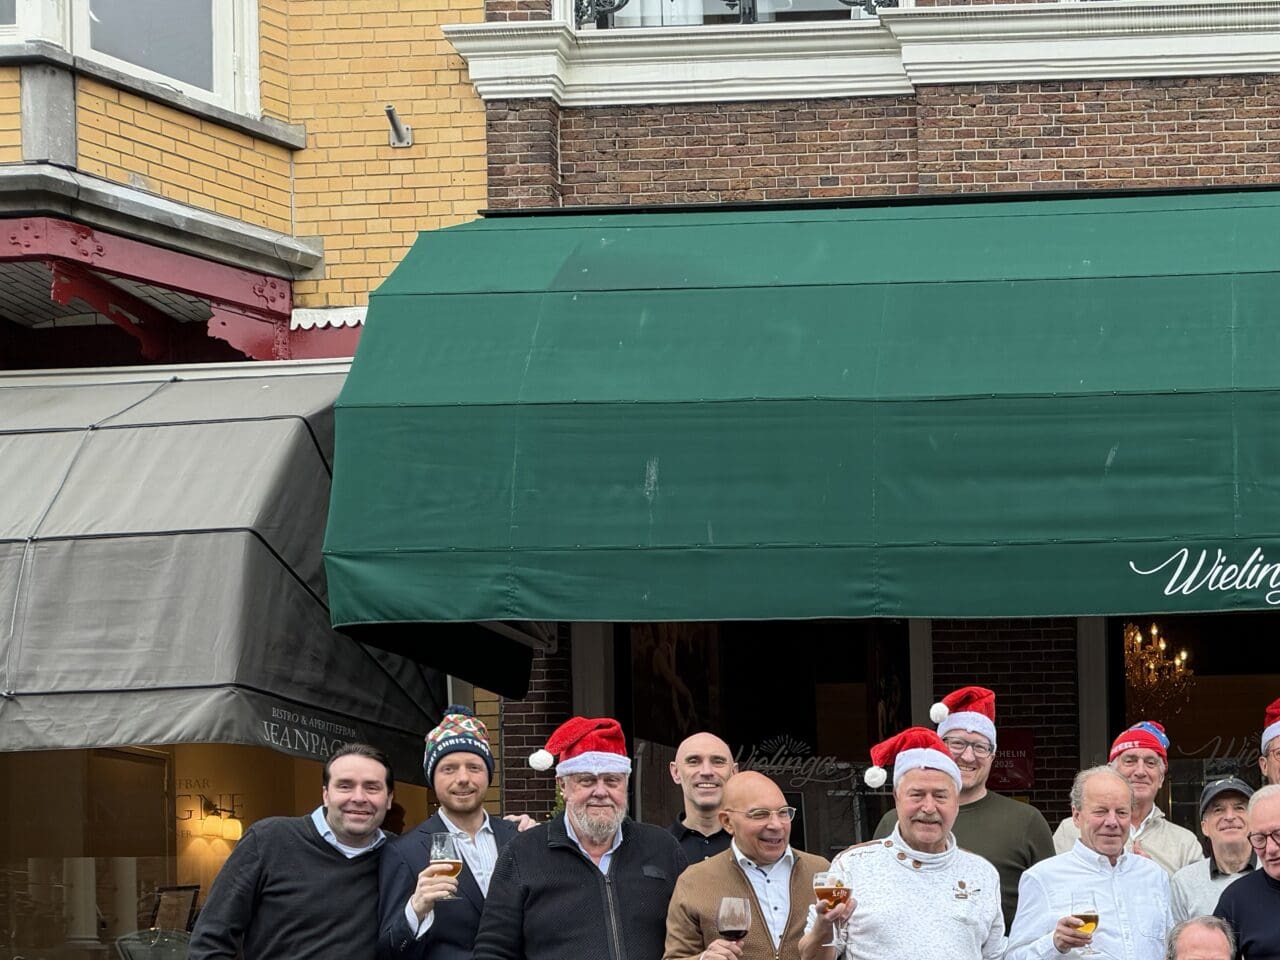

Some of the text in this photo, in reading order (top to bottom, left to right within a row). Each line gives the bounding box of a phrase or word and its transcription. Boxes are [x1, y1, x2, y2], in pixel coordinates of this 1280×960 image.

[272, 707, 299, 722] BISTRO
[262, 721, 345, 758] JEANPAG
[995, 750, 1026, 758] CHELIN
[994, 760, 1014, 768] 2025
